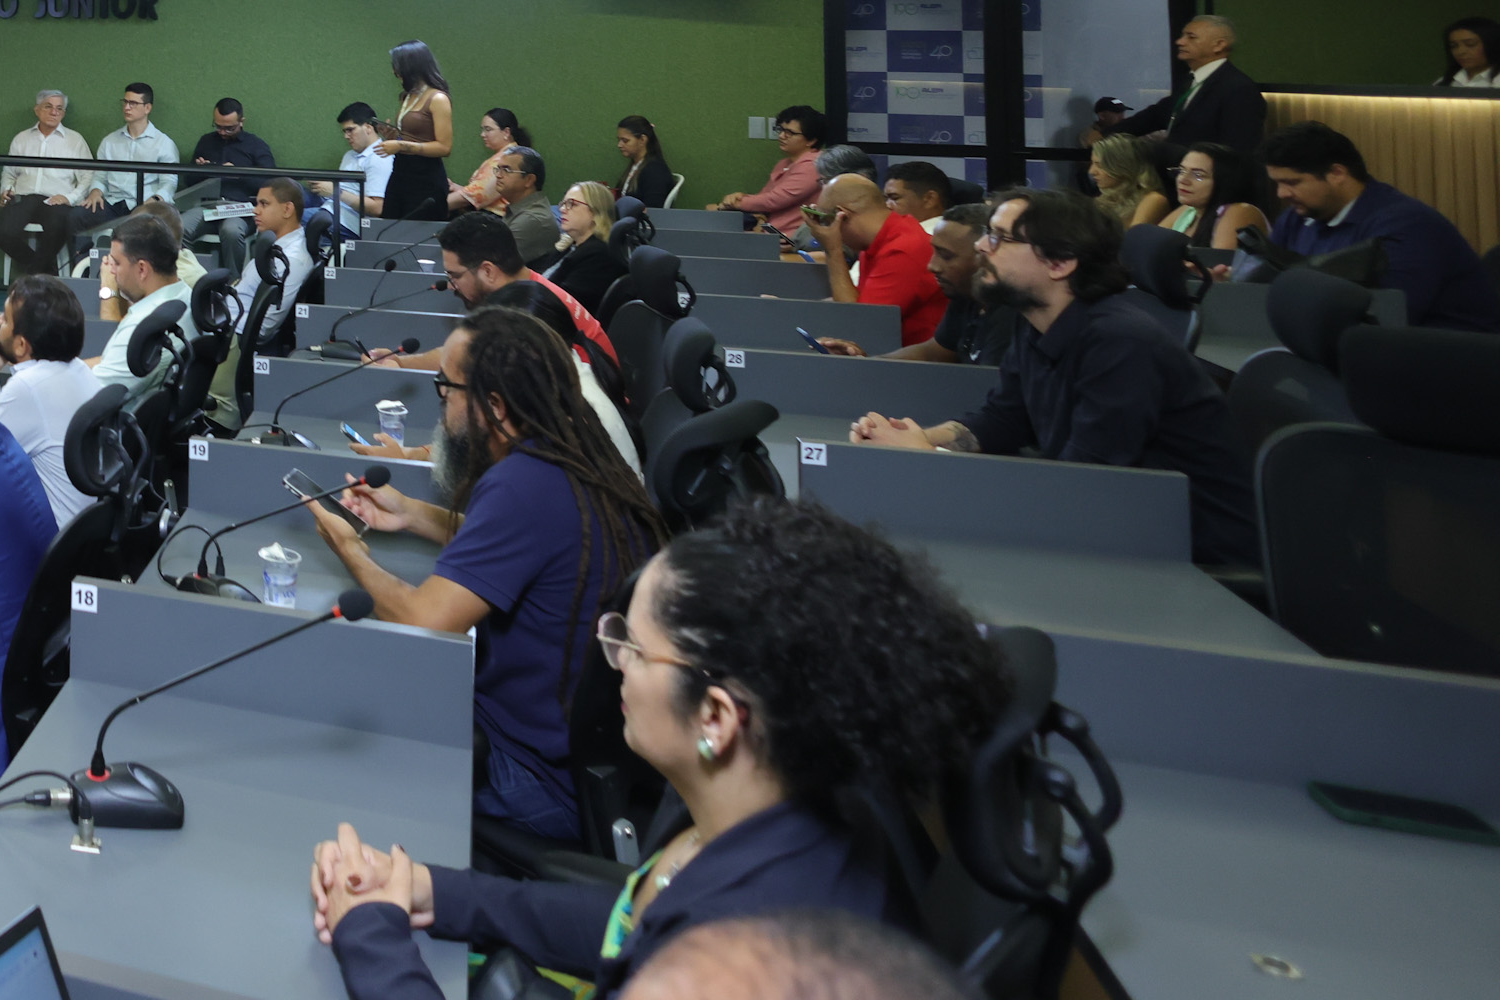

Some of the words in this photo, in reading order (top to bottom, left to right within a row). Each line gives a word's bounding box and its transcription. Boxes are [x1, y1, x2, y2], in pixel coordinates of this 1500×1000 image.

[325, 269, 335, 277] 22
[297, 307, 307, 316] 21
[728, 353, 743, 364] 28
[256, 361, 268, 371] 20
[192, 444, 206, 456] 19
[804, 447, 823, 461] 27
[75, 589, 94, 606] 18
